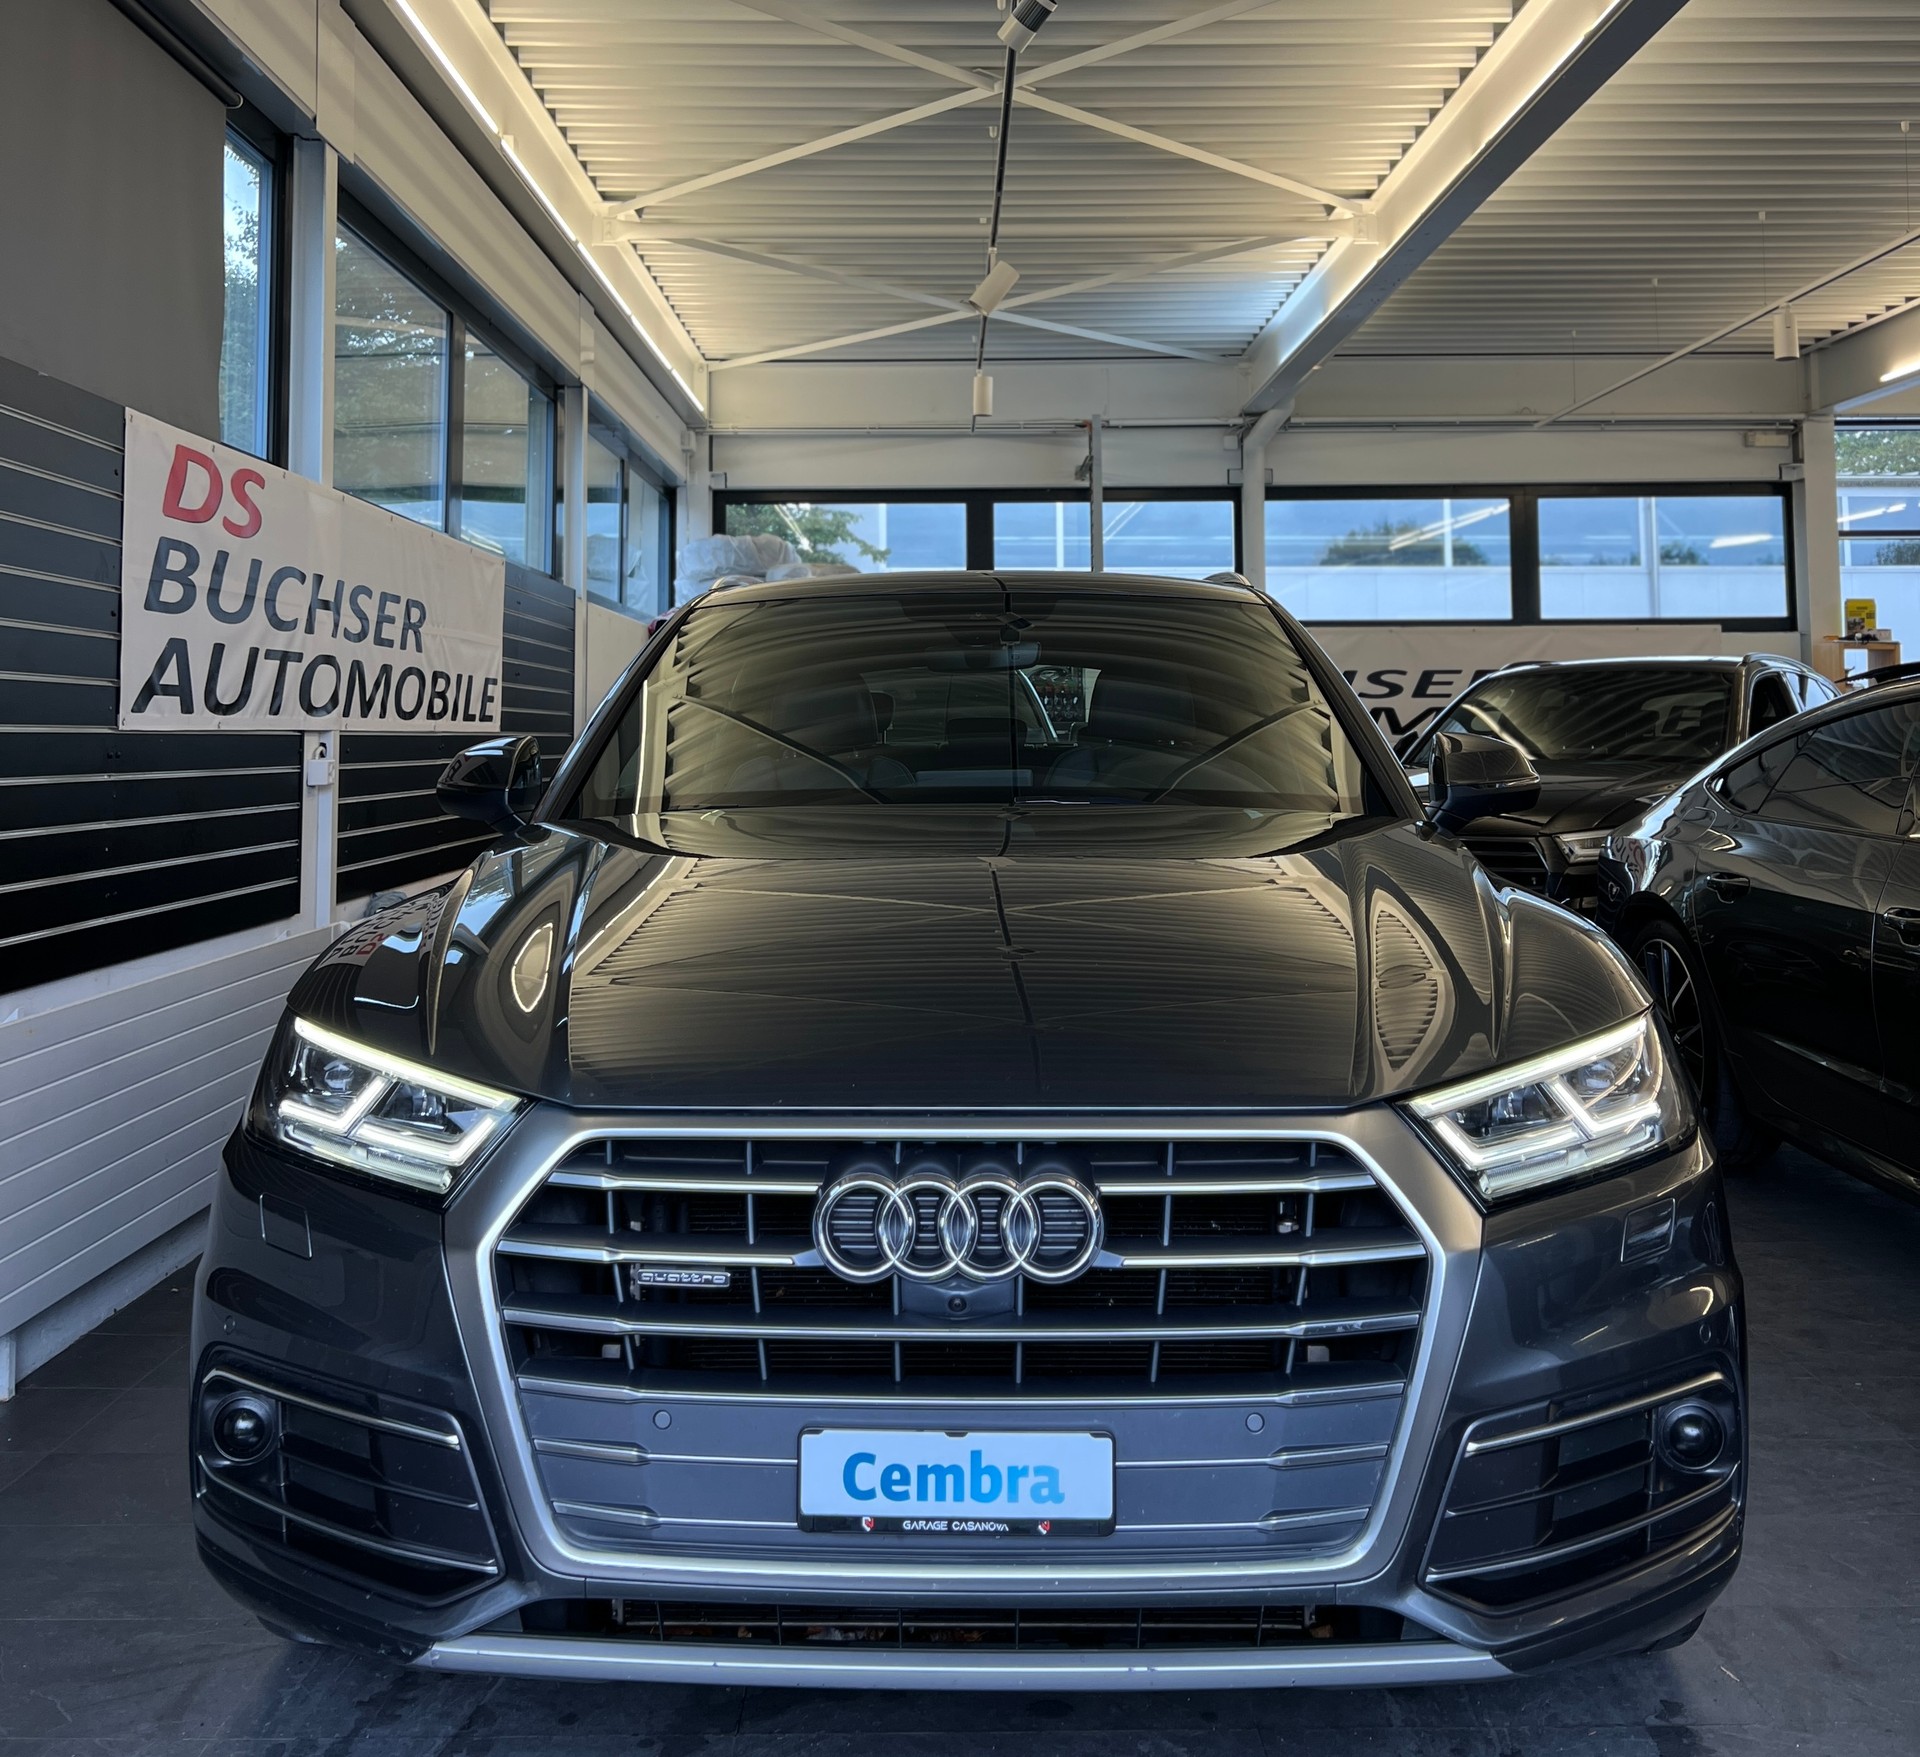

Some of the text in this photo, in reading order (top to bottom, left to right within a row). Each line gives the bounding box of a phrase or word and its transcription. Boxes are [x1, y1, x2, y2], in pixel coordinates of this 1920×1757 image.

[162, 443, 266, 539] DS
[143, 535, 427, 654] BUCHSER
[130, 637, 499, 723] AUTOMOBILE
[641, 1272, 726, 1284] quattro
[842, 1449, 1066, 1505] Cembra
[902, 1520, 1009, 1532] GARAGE CASANOVA
